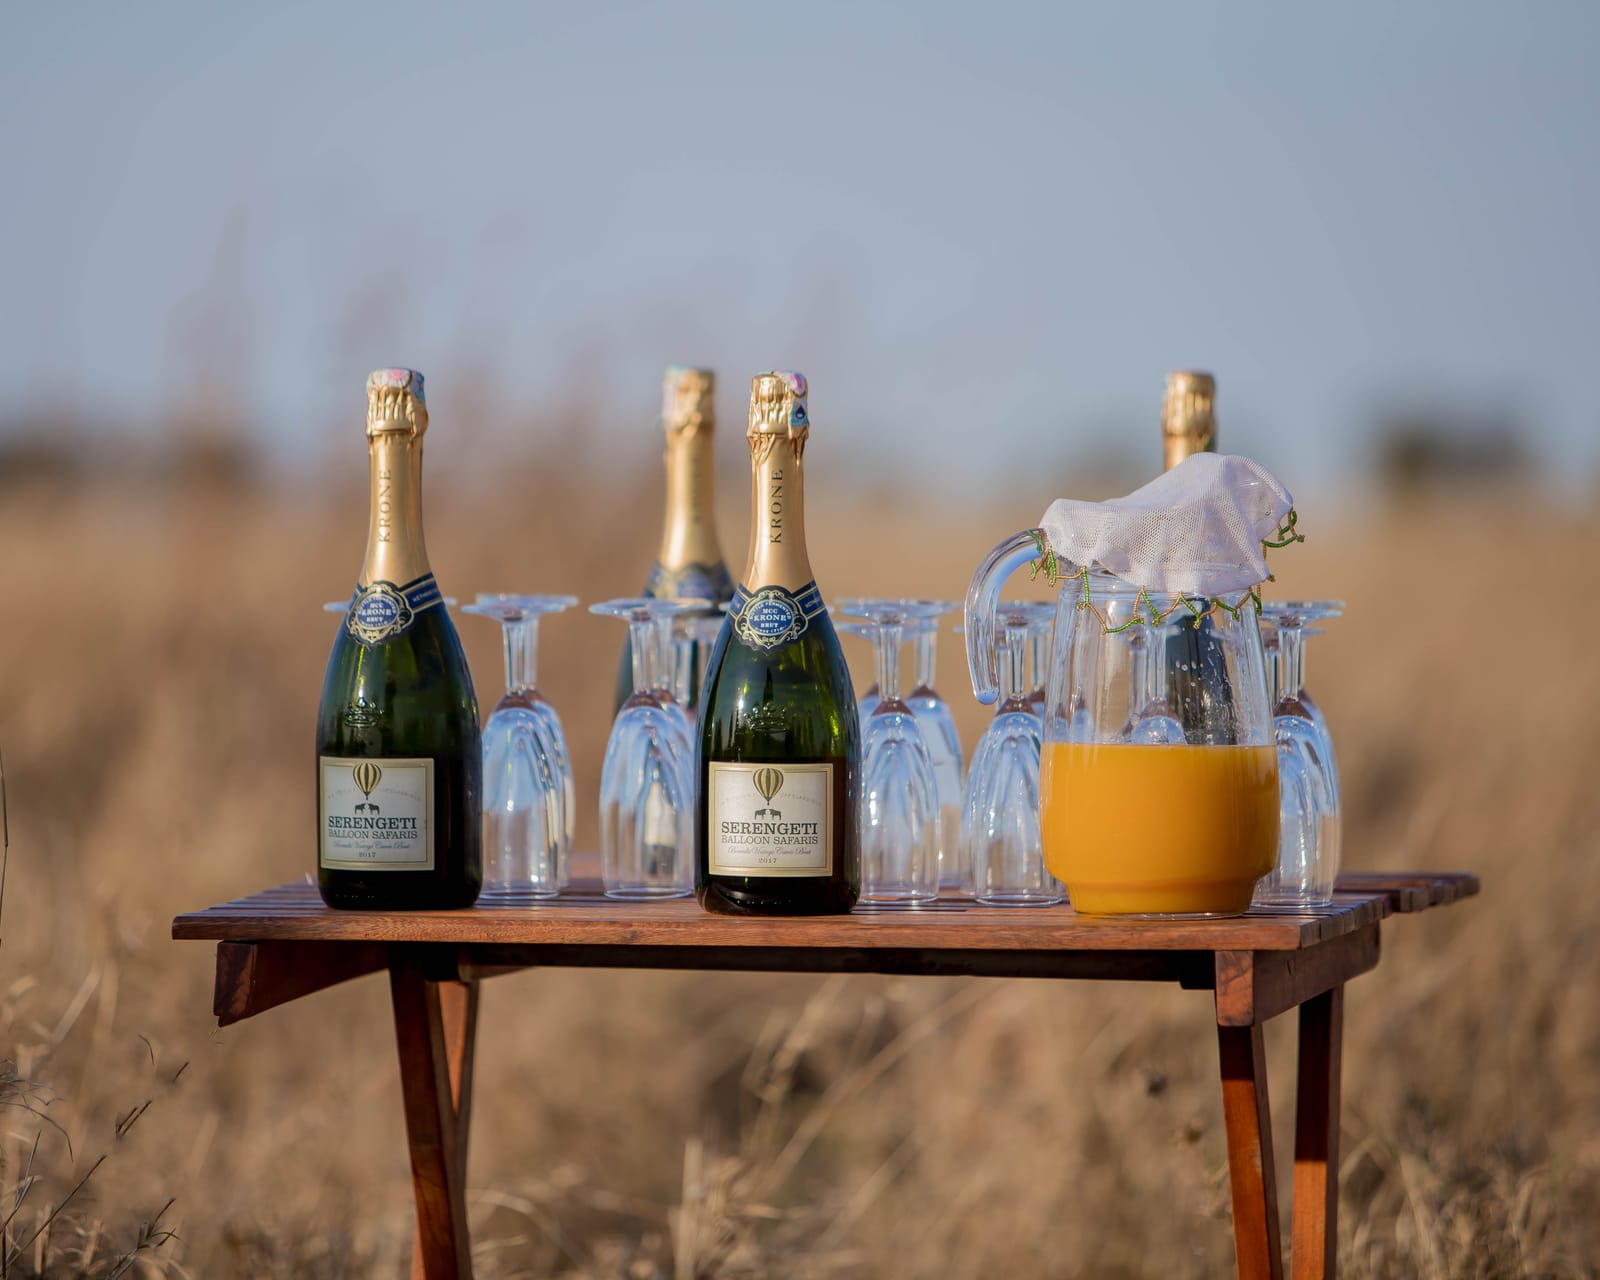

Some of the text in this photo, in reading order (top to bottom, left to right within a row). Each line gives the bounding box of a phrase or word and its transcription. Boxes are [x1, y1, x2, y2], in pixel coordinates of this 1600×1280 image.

[379, 469, 392, 542] KRONE
[770, 469, 783, 544] KRONE
[361, 608, 392, 616] KRONE
[753, 614, 787, 622] KRONE
[328, 815, 417, 830] SERENGETI
[721, 821, 818, 835] SERENGETI
[328, 829, 418, 840] BALLOON SAFARIS
[721, 835, 819, 845] BALLOON SAFARIS
